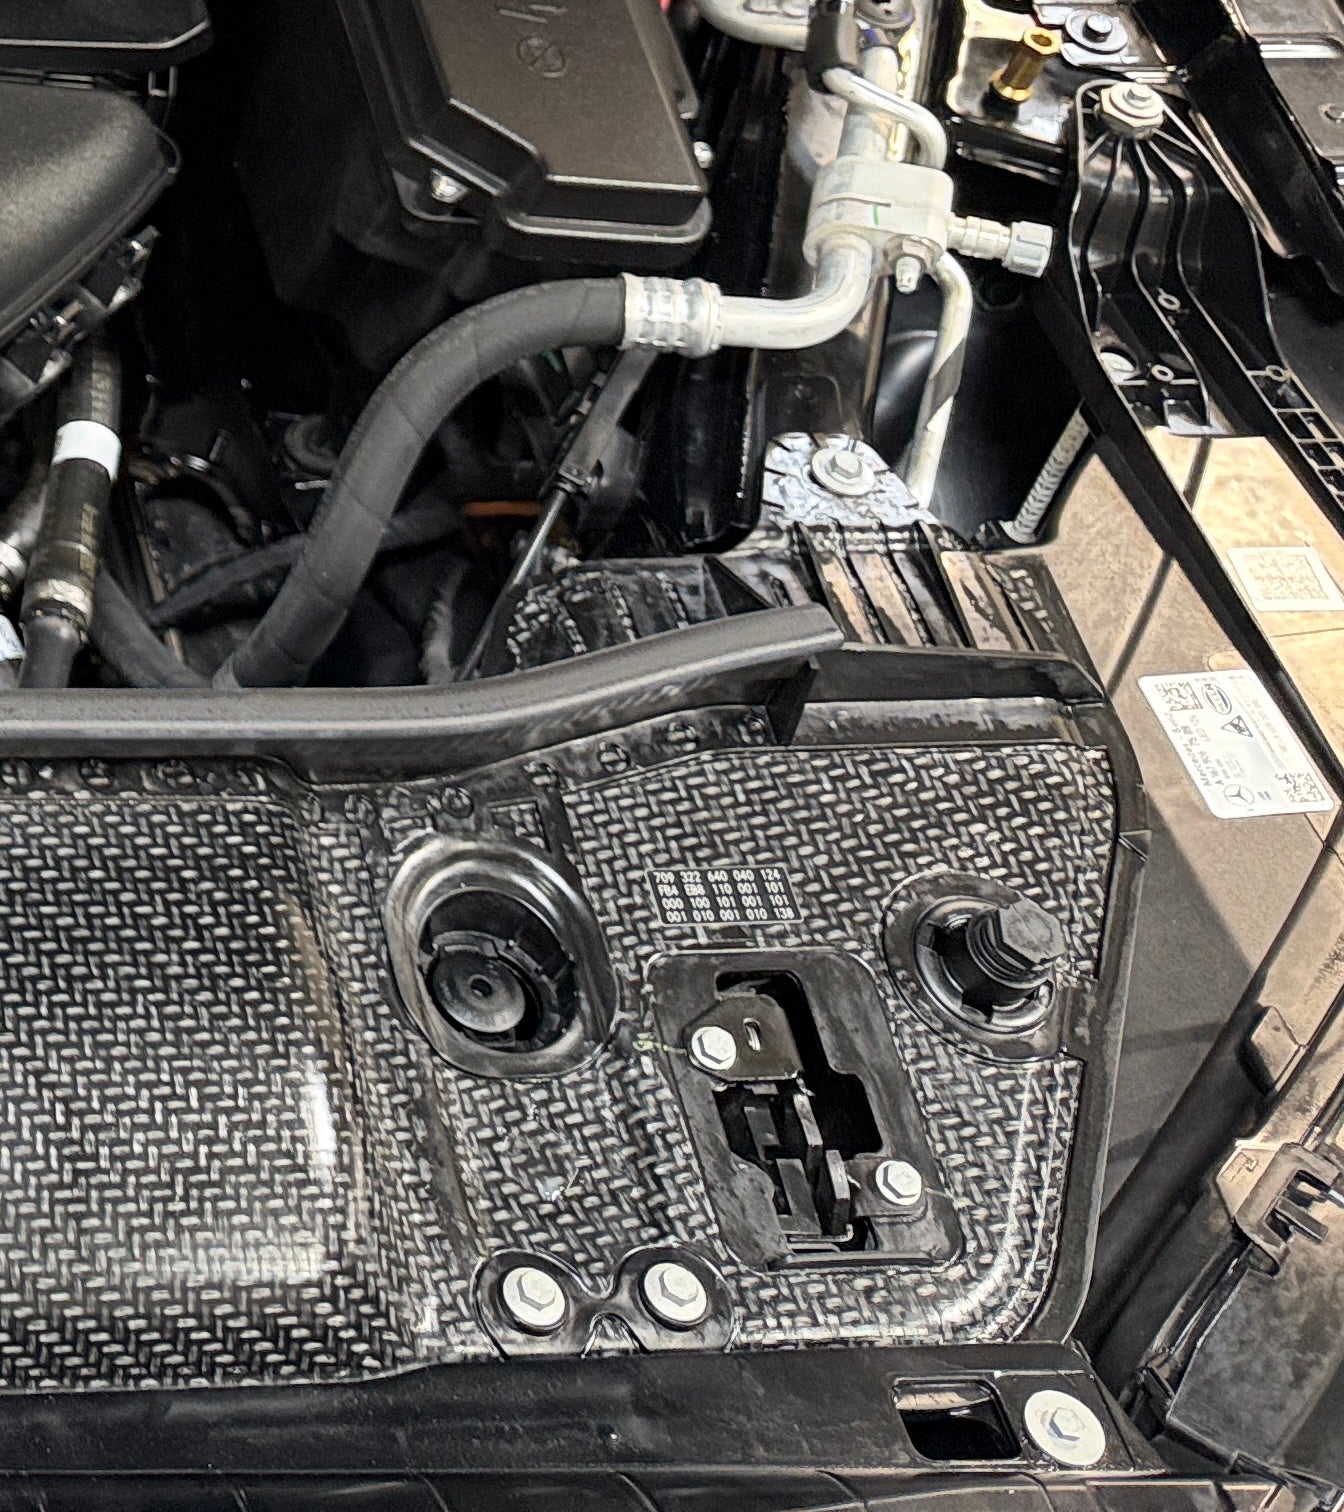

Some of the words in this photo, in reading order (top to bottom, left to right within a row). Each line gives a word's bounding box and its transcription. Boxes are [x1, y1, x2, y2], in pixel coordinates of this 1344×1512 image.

[654, 871, 674, 883] 709
[680, 871, 702, 883] 322
[707, 870, 728, 882] 640
[733, 870, 754, 882] 040
[761, 869, 781, 881] 124
[712, 883, 733, 895] 110
[737, 883, 758, 894] 001
[765, 882, 785, 893] 101
[662, 898, 684, 910] 000
[690, 897, 710, 908] 100
[716, 896, 736, 908] 101
[742, 896, 762, 907] 001
[769, 895, 789, 906] 101
[666, 911, 687, 923] 001
[693, 910, 715, 922] 010
[719, 910, 740, 921] 001
[746, 908, 767, 920] 010
[774, 908, 794, 919] 138
